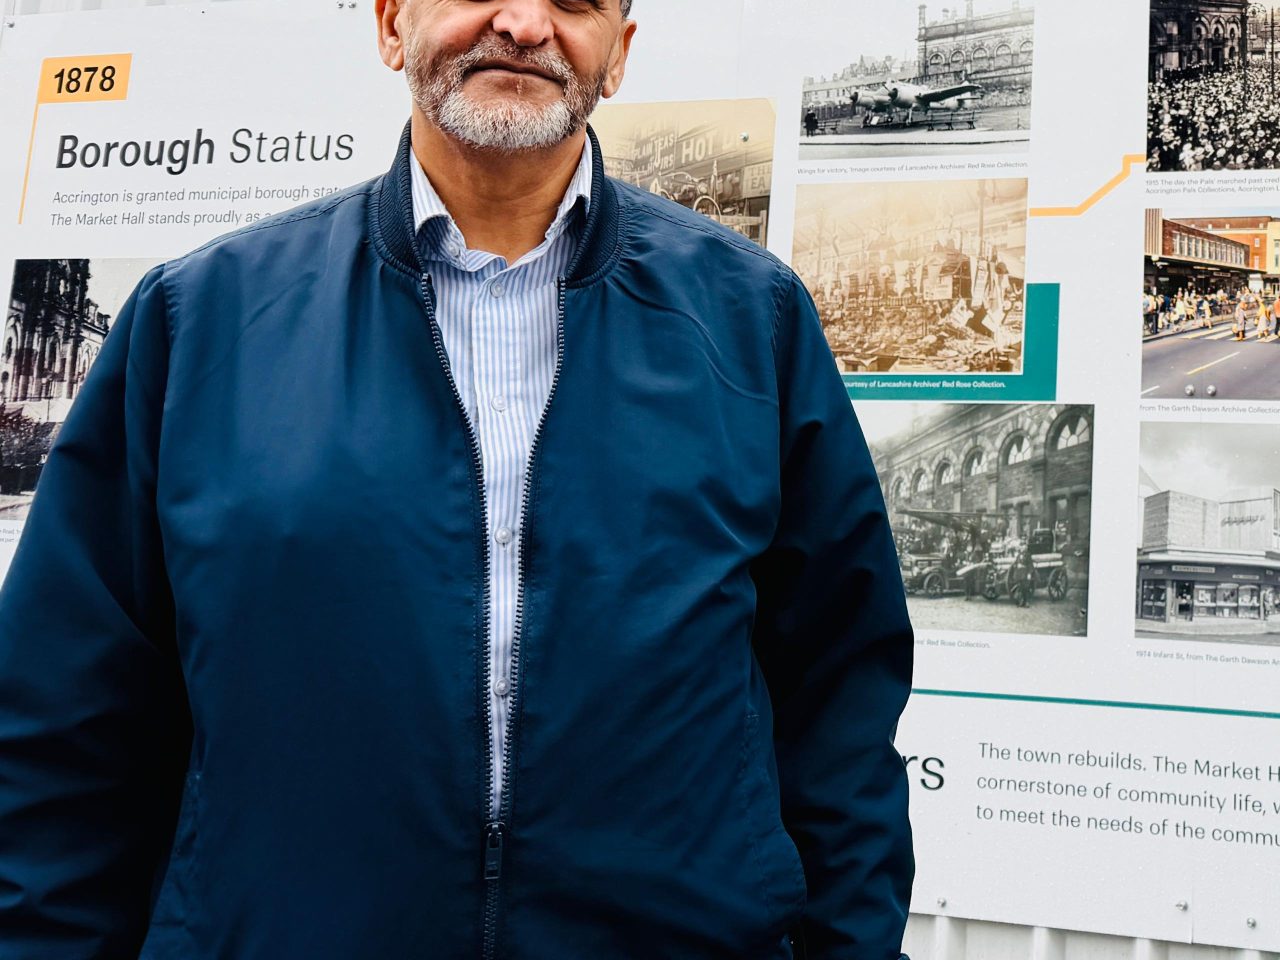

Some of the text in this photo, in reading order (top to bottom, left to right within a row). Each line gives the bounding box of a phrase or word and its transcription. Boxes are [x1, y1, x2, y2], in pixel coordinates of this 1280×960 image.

[53, 65, 116, 94] 1878
[56, 128, 354, 175] Borough Status
[52, 185, 344, 207] Accrington is granted municipal borough stat
[50, 213, 73, 227] The
[75, 212, 118, 226] Market
[121, 211, 146, 226] Hall
[148, 210, 190, 225] stands
[193, 210, 242, 226] proudly
[246, 213, 260, 222] as
[845, 380, 868, 389] ourtesy
[877, 380, 912, 388] Lancashire
[942, 380, 955, 388] Red
[956, 380, 972, 388] Rose
[978, 742, 1012, 761] The
[1016, 746, 1062, 766] town
[1067, 750, 1148, 772] rebuilds.
[1152, 756, 1188, 776] The
[1194, 760, 1261, 782] Market
[976, 776, 1088, 798] cornerstone
[1093, 782, 1114, 800] of
[1117, 784, 1228, 814] community
[1232, 794, 1268, 818] life,
[976, 804, 994, 822] to
[999, 807, 1046, 827] meet
[1051, 810, 1082, 829] the
[1086, 814, 1144, 836] needs
[1149, 818, 1170, 836] of
[1174, 820, 1206, 841] the
